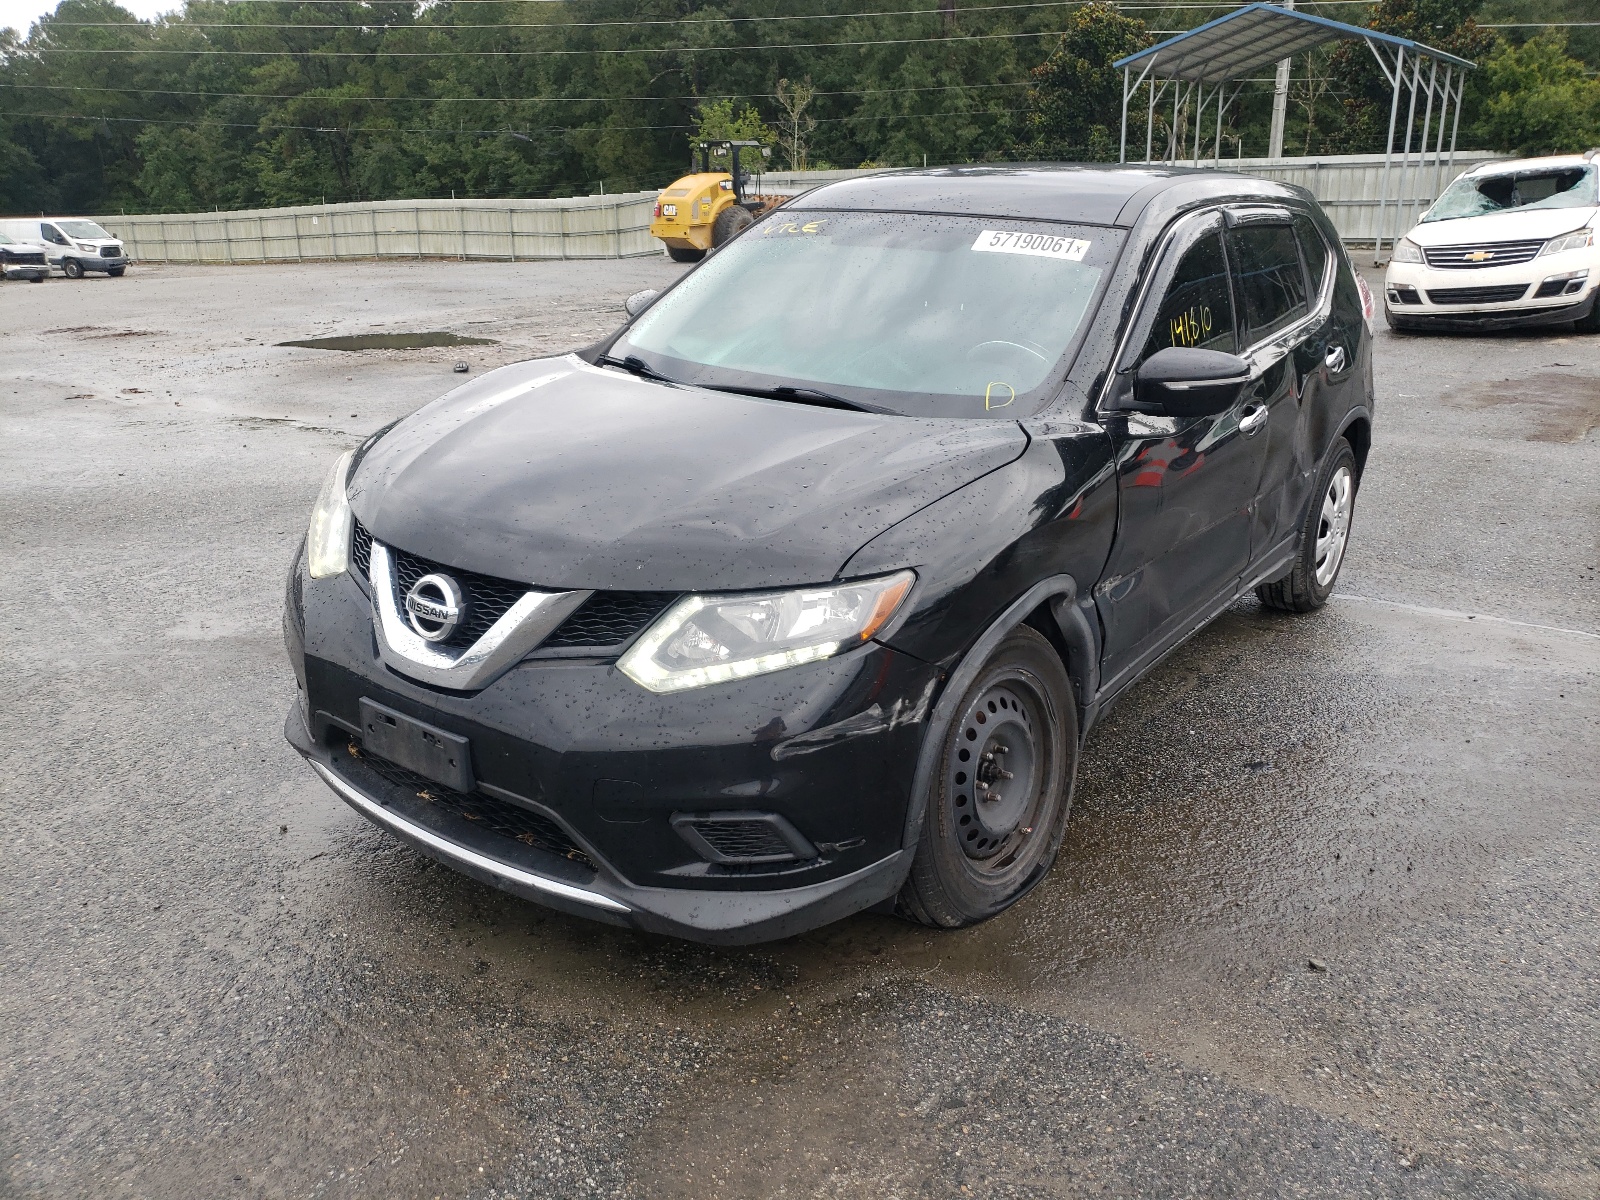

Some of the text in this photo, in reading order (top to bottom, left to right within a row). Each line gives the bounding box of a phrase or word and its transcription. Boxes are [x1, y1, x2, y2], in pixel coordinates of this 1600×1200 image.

[663, 204, 676, 216] CAT
[985, 381, 1015, 411] D
[407, 598, 449, 620] NISSAN
